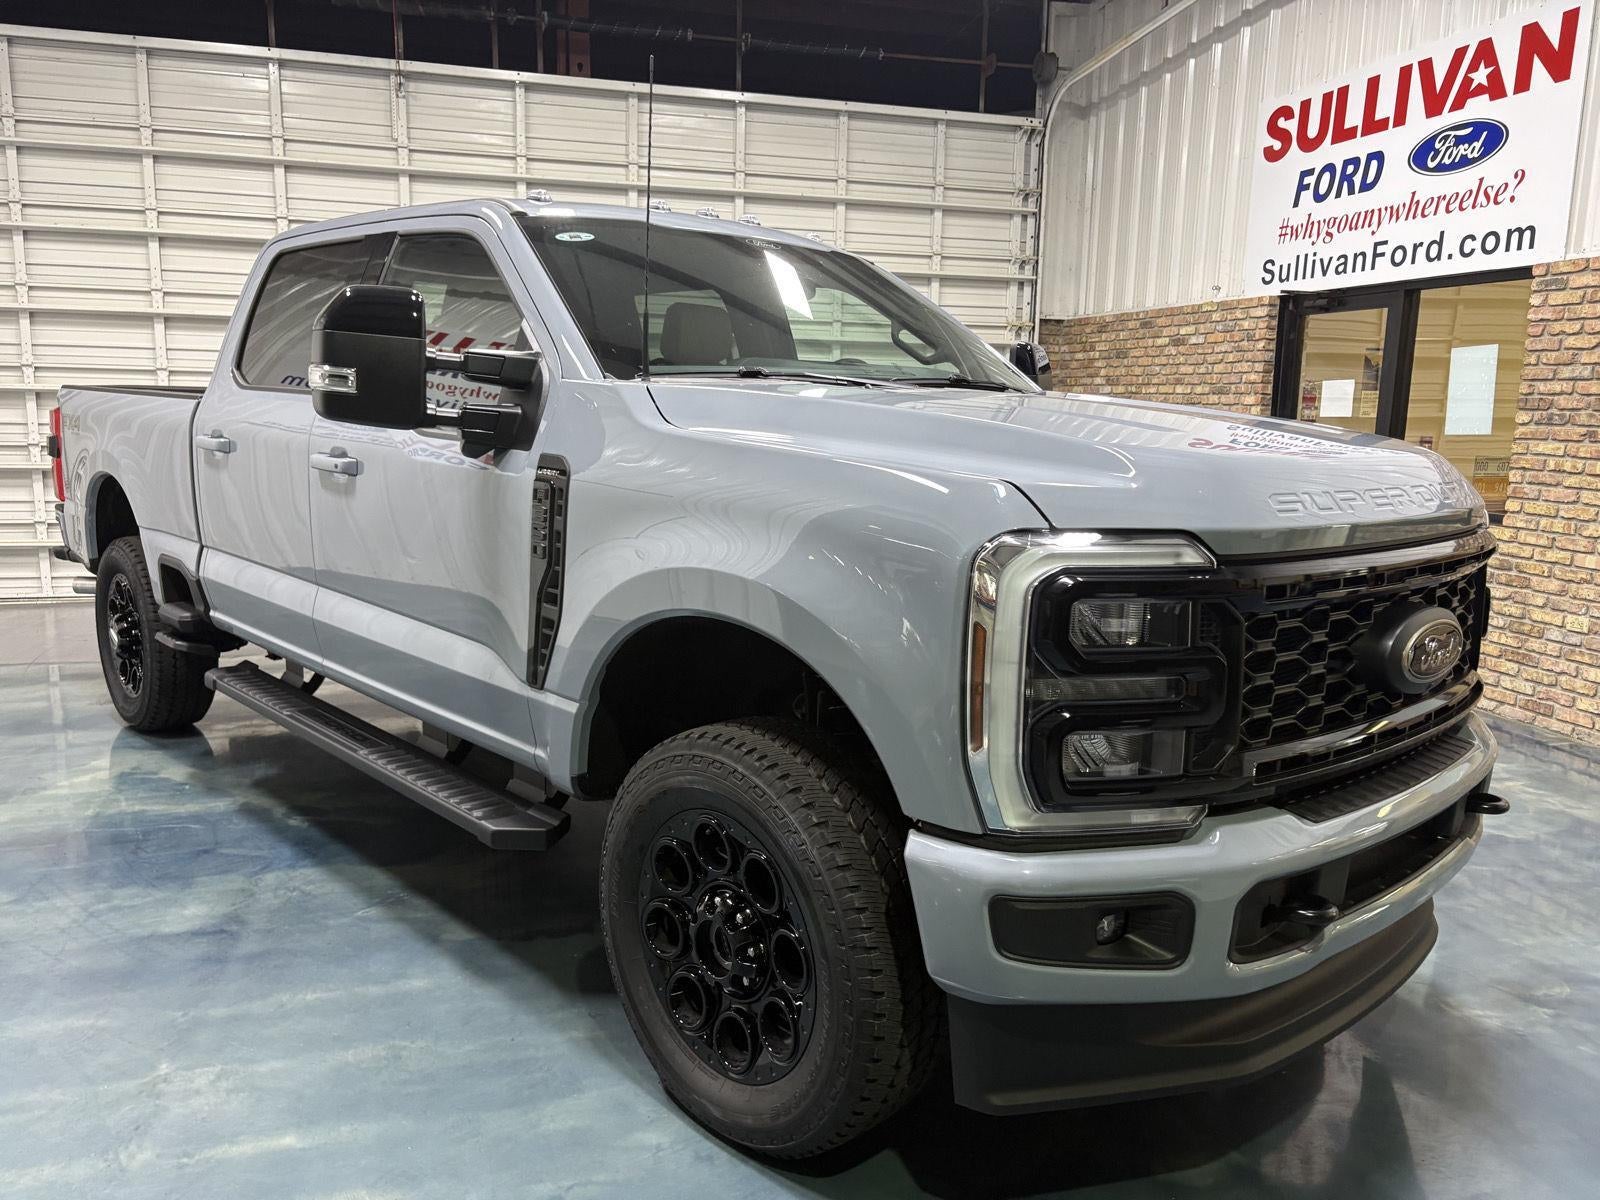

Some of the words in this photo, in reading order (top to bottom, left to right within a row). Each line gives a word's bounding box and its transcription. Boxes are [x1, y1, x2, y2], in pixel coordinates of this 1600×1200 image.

[1262, 6, 1581, 163] SULLIVAN
[1427, 127, 1488, 169] Ford
[1277, 168, 1526, 246] #whygoanywhereelse?
[1292, 150, 1385, 208] FORD
[1261, 225, 1537, 286] SullivanFord.com
[1419, 633, 1455, 671] Ford
